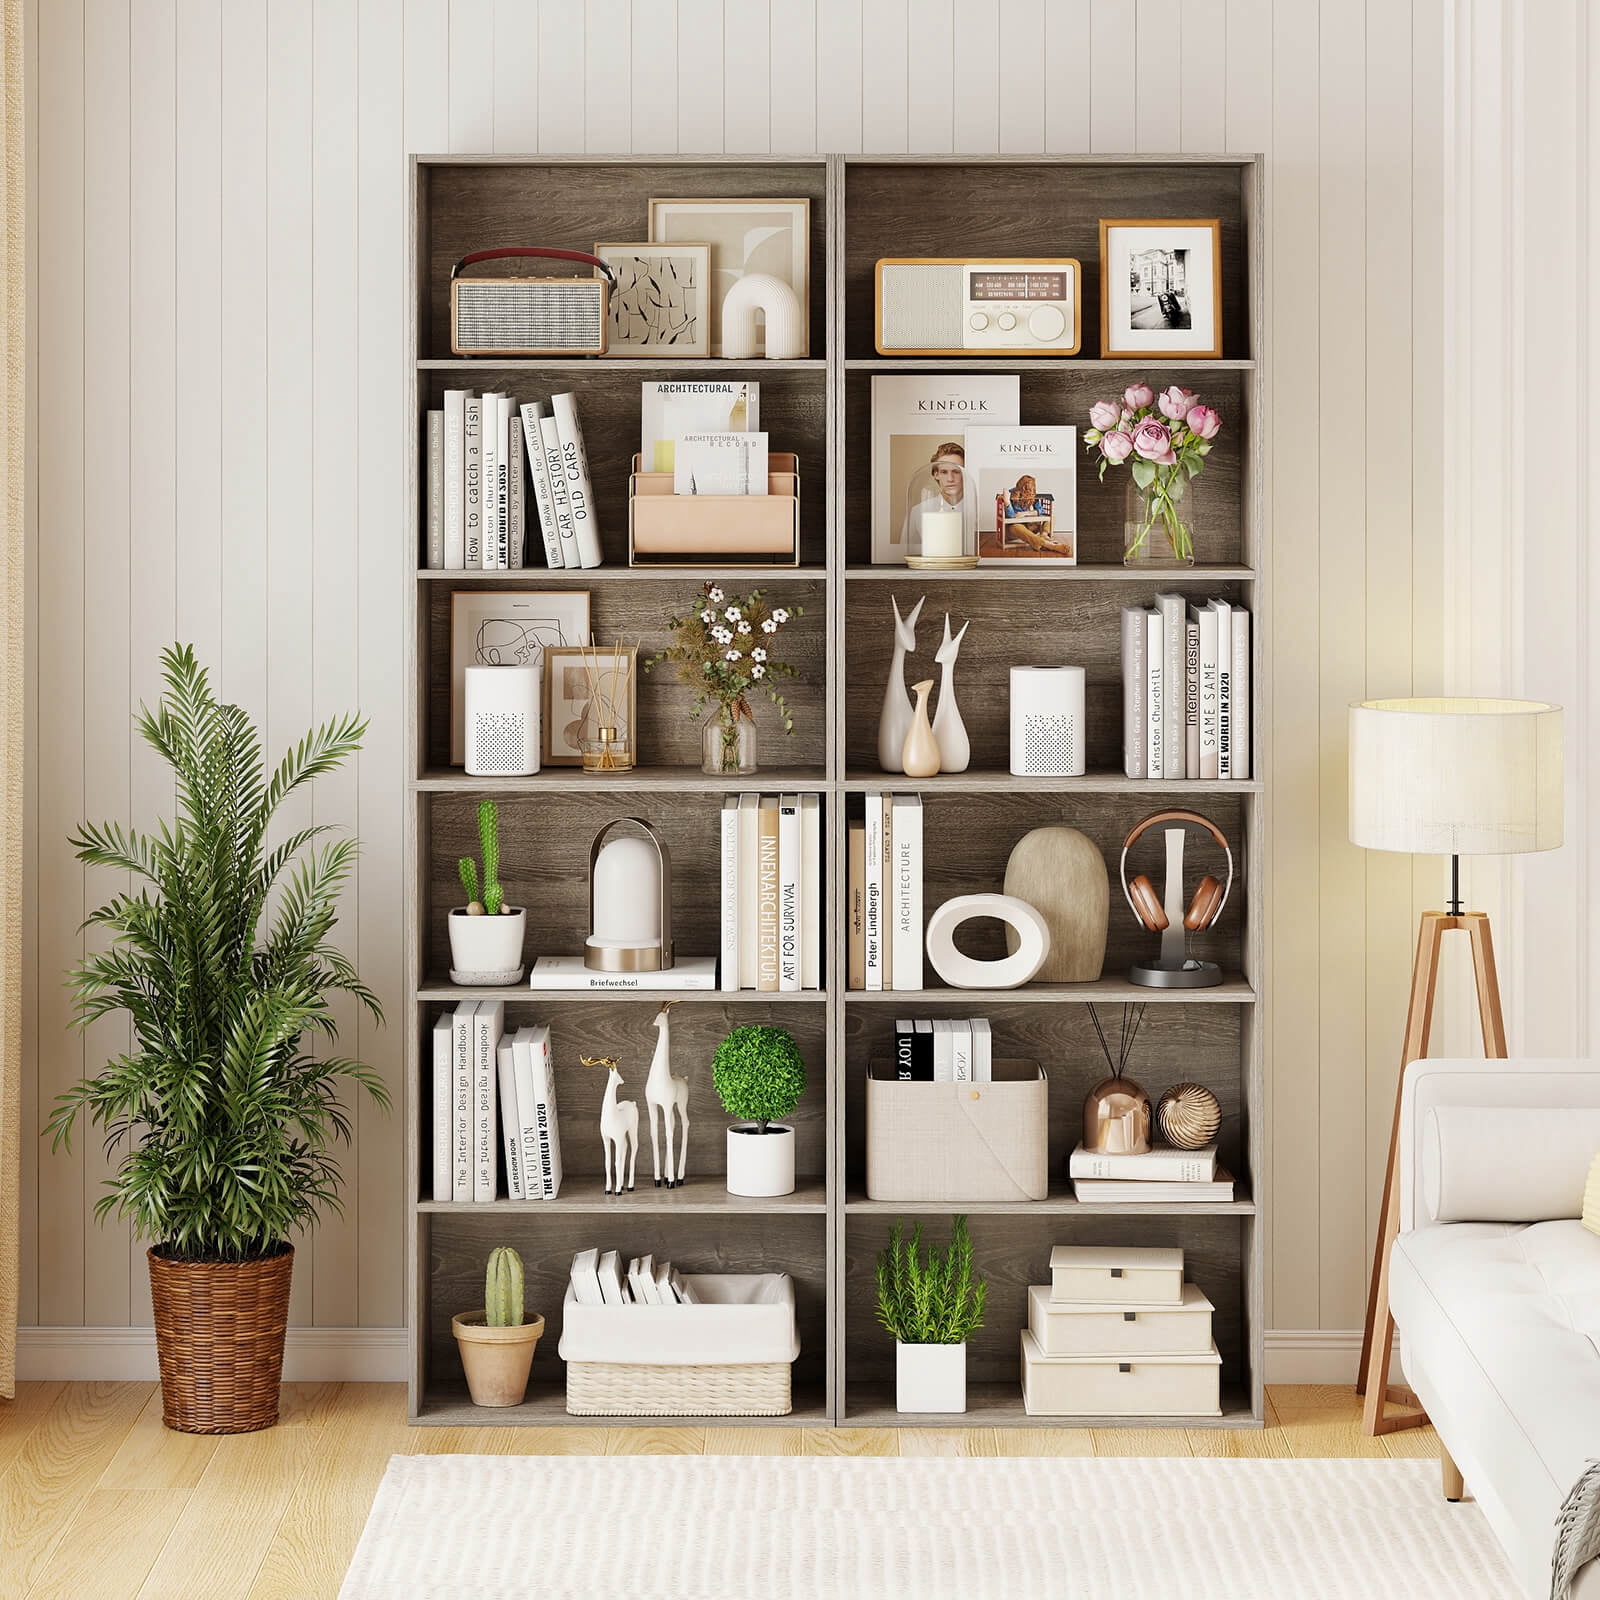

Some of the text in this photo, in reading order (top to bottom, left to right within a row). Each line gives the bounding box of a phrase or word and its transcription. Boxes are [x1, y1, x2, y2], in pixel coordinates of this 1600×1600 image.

[526, 407, 540, 451] children
[657, 384, 733, 393] ARCHITECTURAL
[918, 400, 989, 410] KINFOLK
[466, 405, 479, 562] How to catch a fish
[535, 457, 544, 472] for
[563, 442, 587, 519] OLD CARS
[1000, 444, 1053, 453] KINFOLK
[486, 450, 494, 562] Winston Churchill
[511, 419, 520, 566] Steve Jobs by Walter Isaacson
[543, 503, 553, 526] DRAW
[547, 446, 574, 539] CAR HISTORY
[547, 531, 555, 541] TO
[550, 547, 560, 564] HOW
[1152, 668, 1160, 772] Winston Churchill
[1186, 630, 1199, 726] Interior design
[1204, 663, 1215, 746] SAME SAME
[1220, 672, 1229, 774] THE WORLD IN 2020
[761, 835, 776, 982] INNENARCHITEKTUR
[867, 883, 879, 967] Peter Lindbergh
[901, 843, 910, 932] ARCHITECTURE
[783, 883, 795, 981] ART FOR SURVIVAL
[458, 1024, 468, 1186] The Interior Design Handbook
[523, 1126, 539, 1195] INTUITION
[537, 1103, 553, 1195] THE WORLD IN 2020
